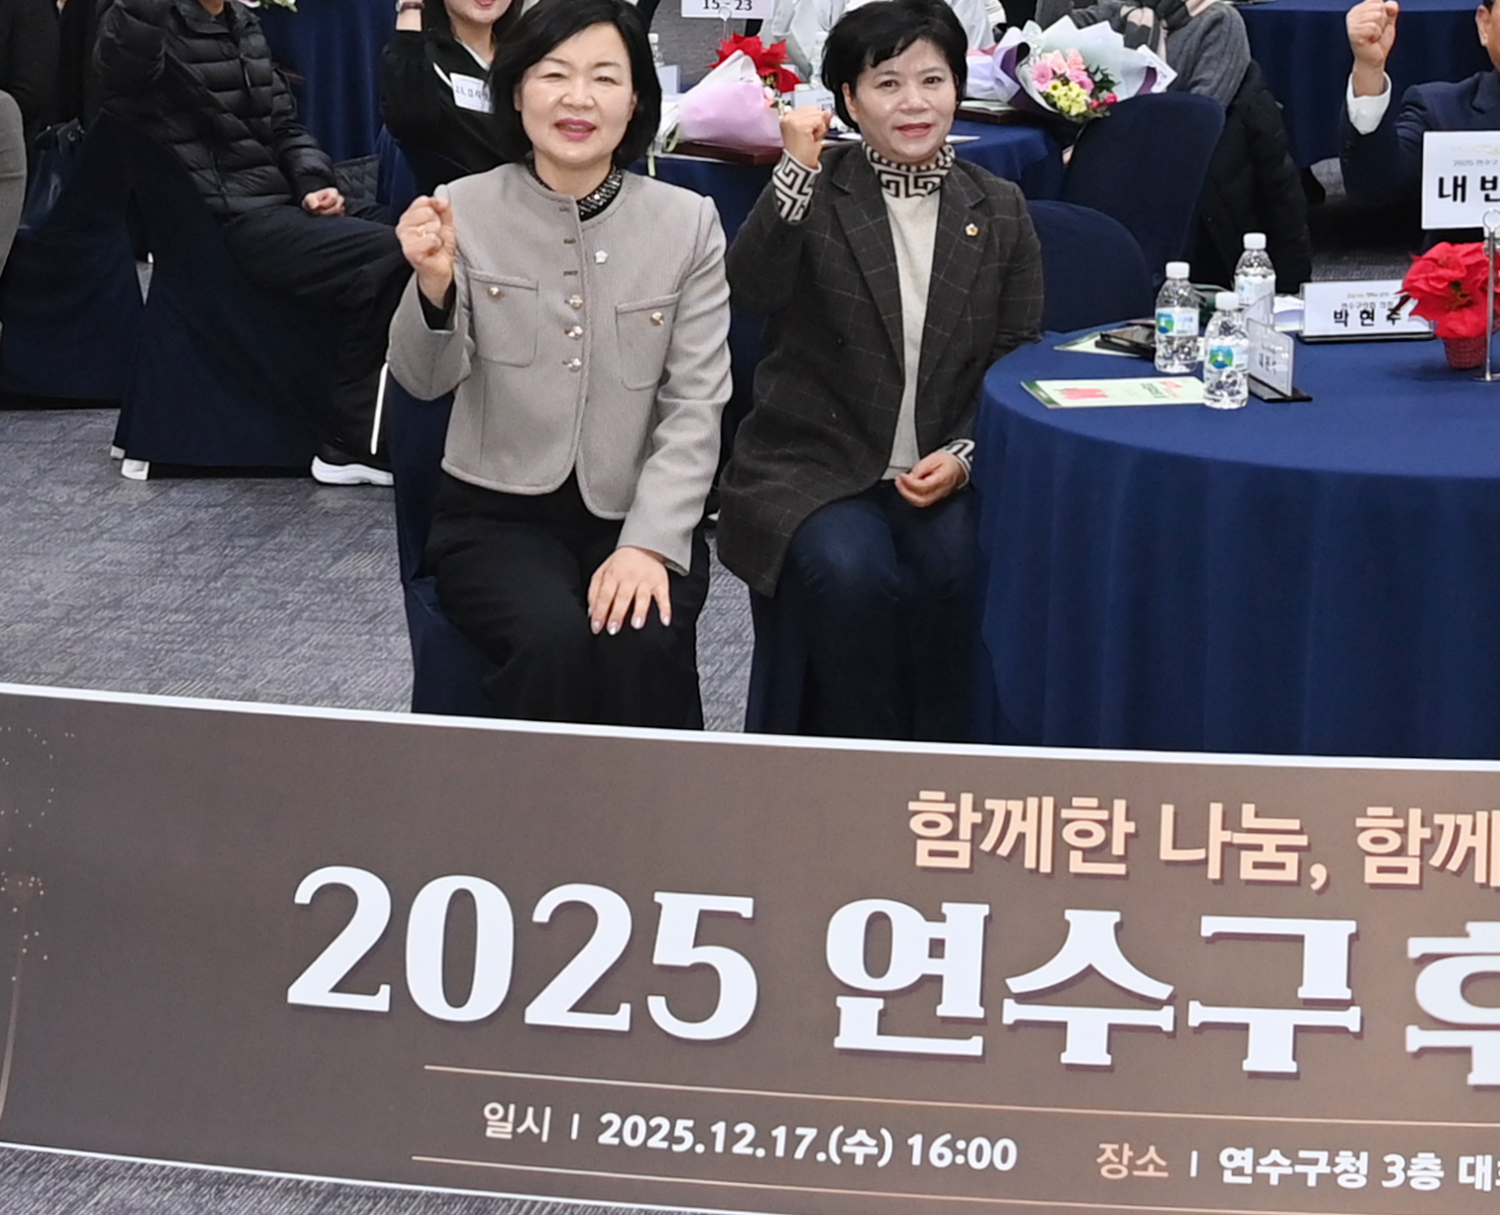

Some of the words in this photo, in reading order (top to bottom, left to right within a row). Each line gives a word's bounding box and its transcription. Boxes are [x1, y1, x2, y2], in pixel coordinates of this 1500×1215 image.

[908, 790, 1136, 877] 함께한
[1158, 801, 1330, 891] 나눔,
[286, 865, 759, 1041] 2025
[825, 897, 1363, 1074] 연수구
[483, 1102, 551, 1143] 일시
[598, 1110, 893, 1169] 2025.12.17.(수)
[906, 1132, 1018, 1172] 16:00
[1096, 1141, 1169, 1180] 장소
[1218, 1148, 1369, 1189] 연수구청
[1381, 1152, 1441, 1191] 3층
